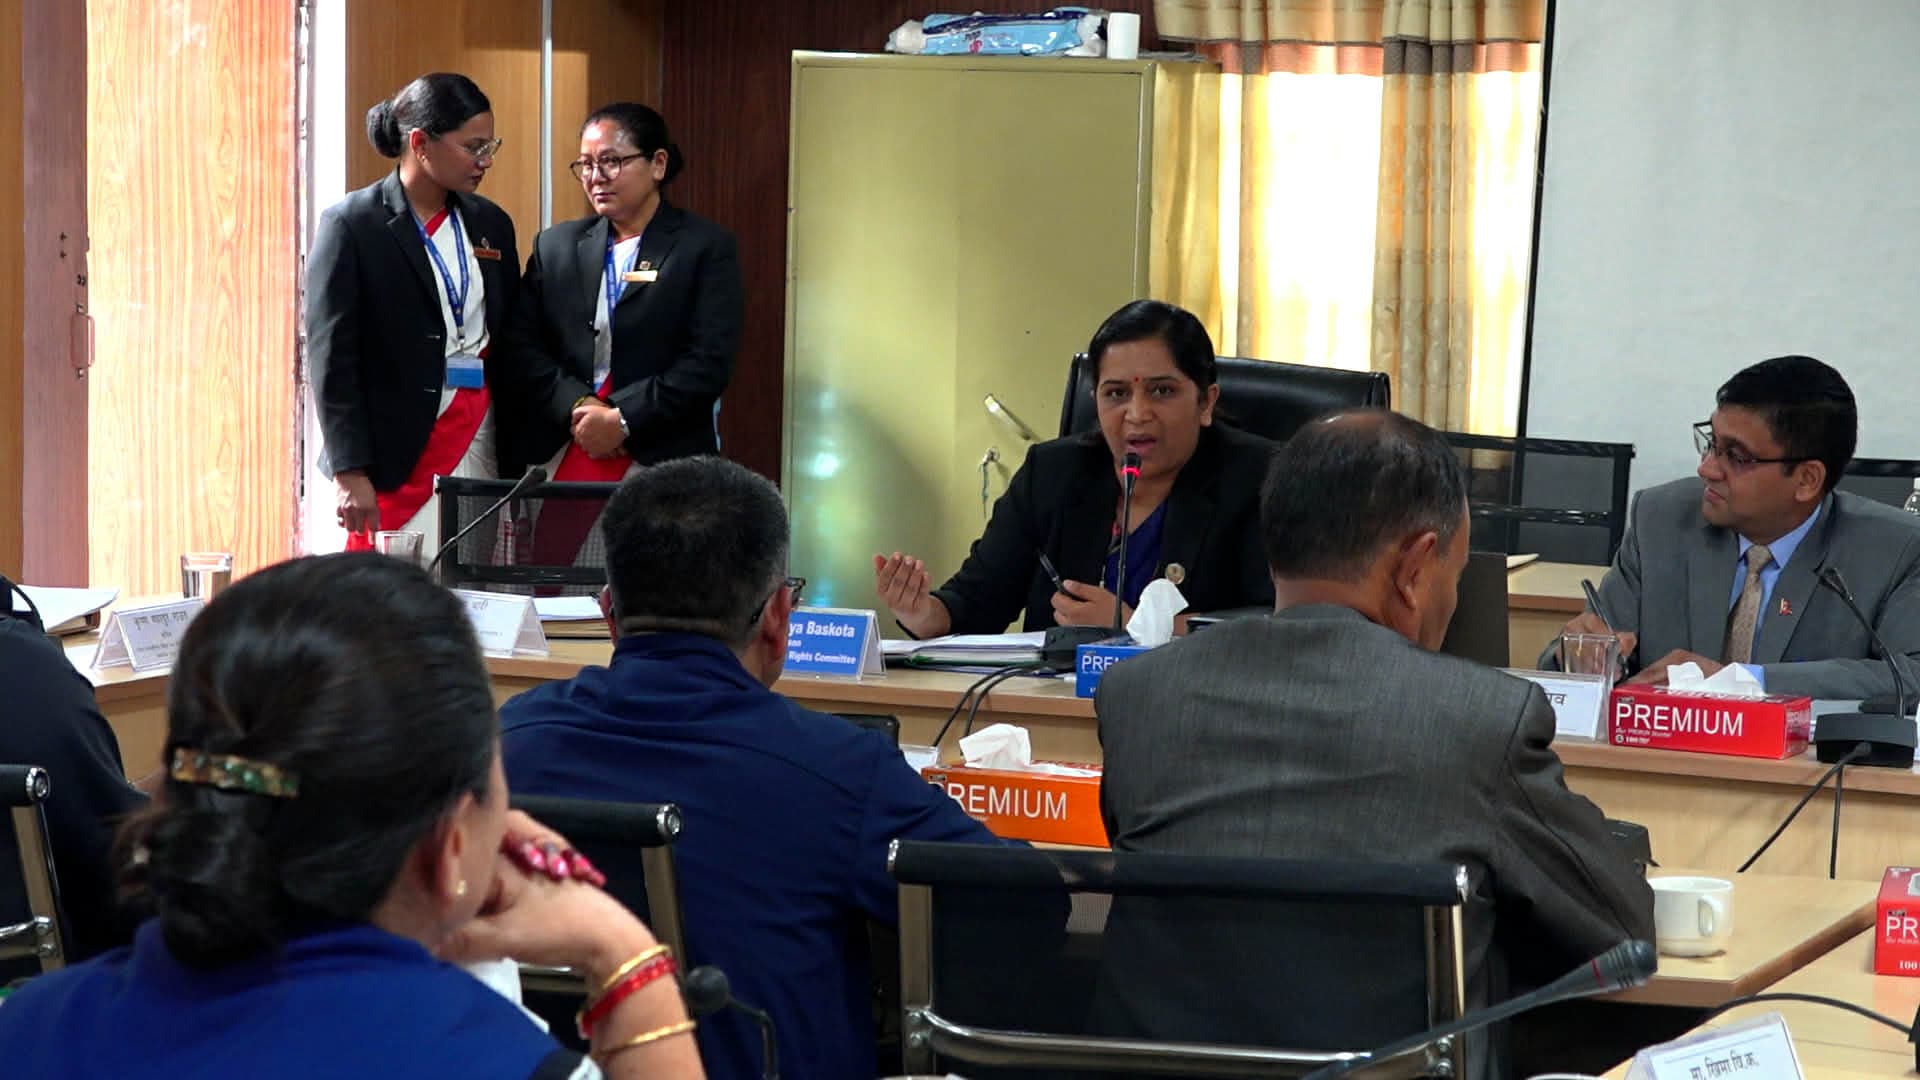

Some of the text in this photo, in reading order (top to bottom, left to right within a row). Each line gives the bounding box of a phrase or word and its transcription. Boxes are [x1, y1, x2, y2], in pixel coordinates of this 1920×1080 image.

[788, 621, 855, 638] ya Baskota
[788, 650, 857, 664] Rights Committee
[1615, 702, 1744, 737] PREMIUM
[927, 781, 1067, 821] REMIUM
[1886, 916, 1919, 939] PR
